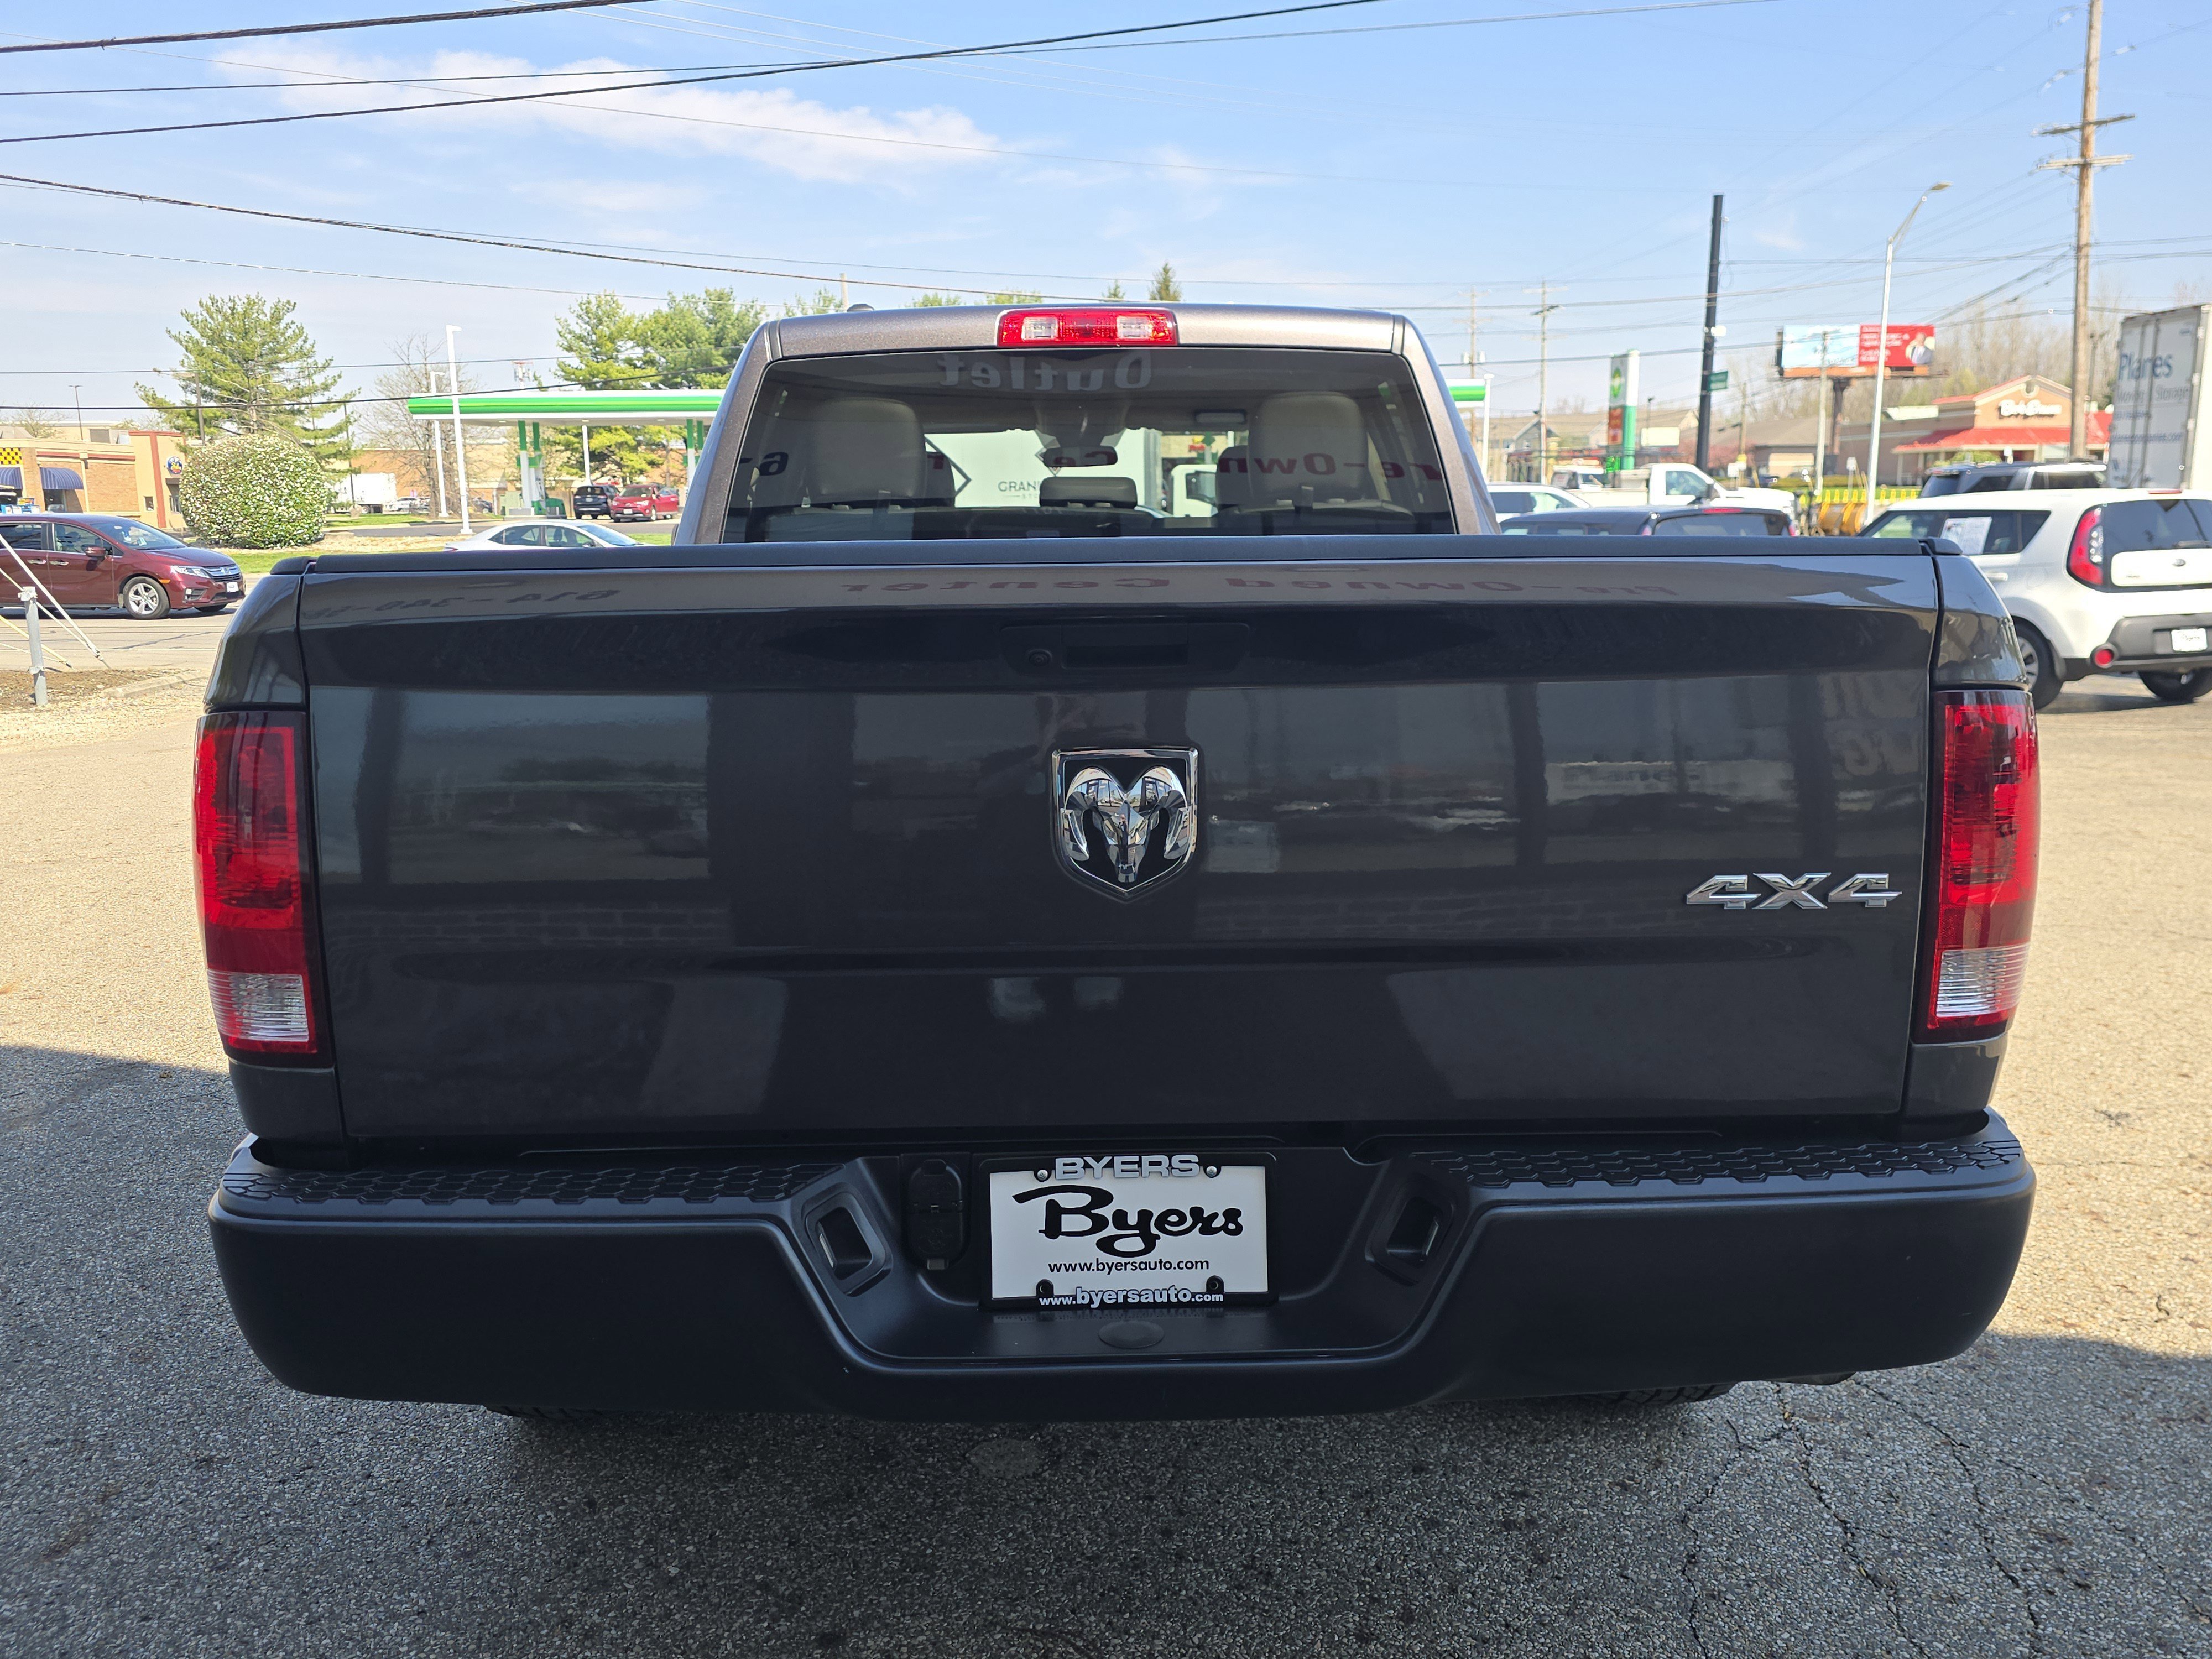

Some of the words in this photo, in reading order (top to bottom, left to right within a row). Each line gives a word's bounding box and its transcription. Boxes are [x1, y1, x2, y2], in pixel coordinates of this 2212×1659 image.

[2119, 352, 2173, 382] Planes
[1686, 872, 1902, 909] 4X4
[1055, 1154, 1201, 1180] BYERS
[1011, 1185, 1244, 1258] Byers
[1048, 1258, 1209, 1275] www.byersauto.com
[1039, 1287, 1224, 1308] www.byersauto.com
